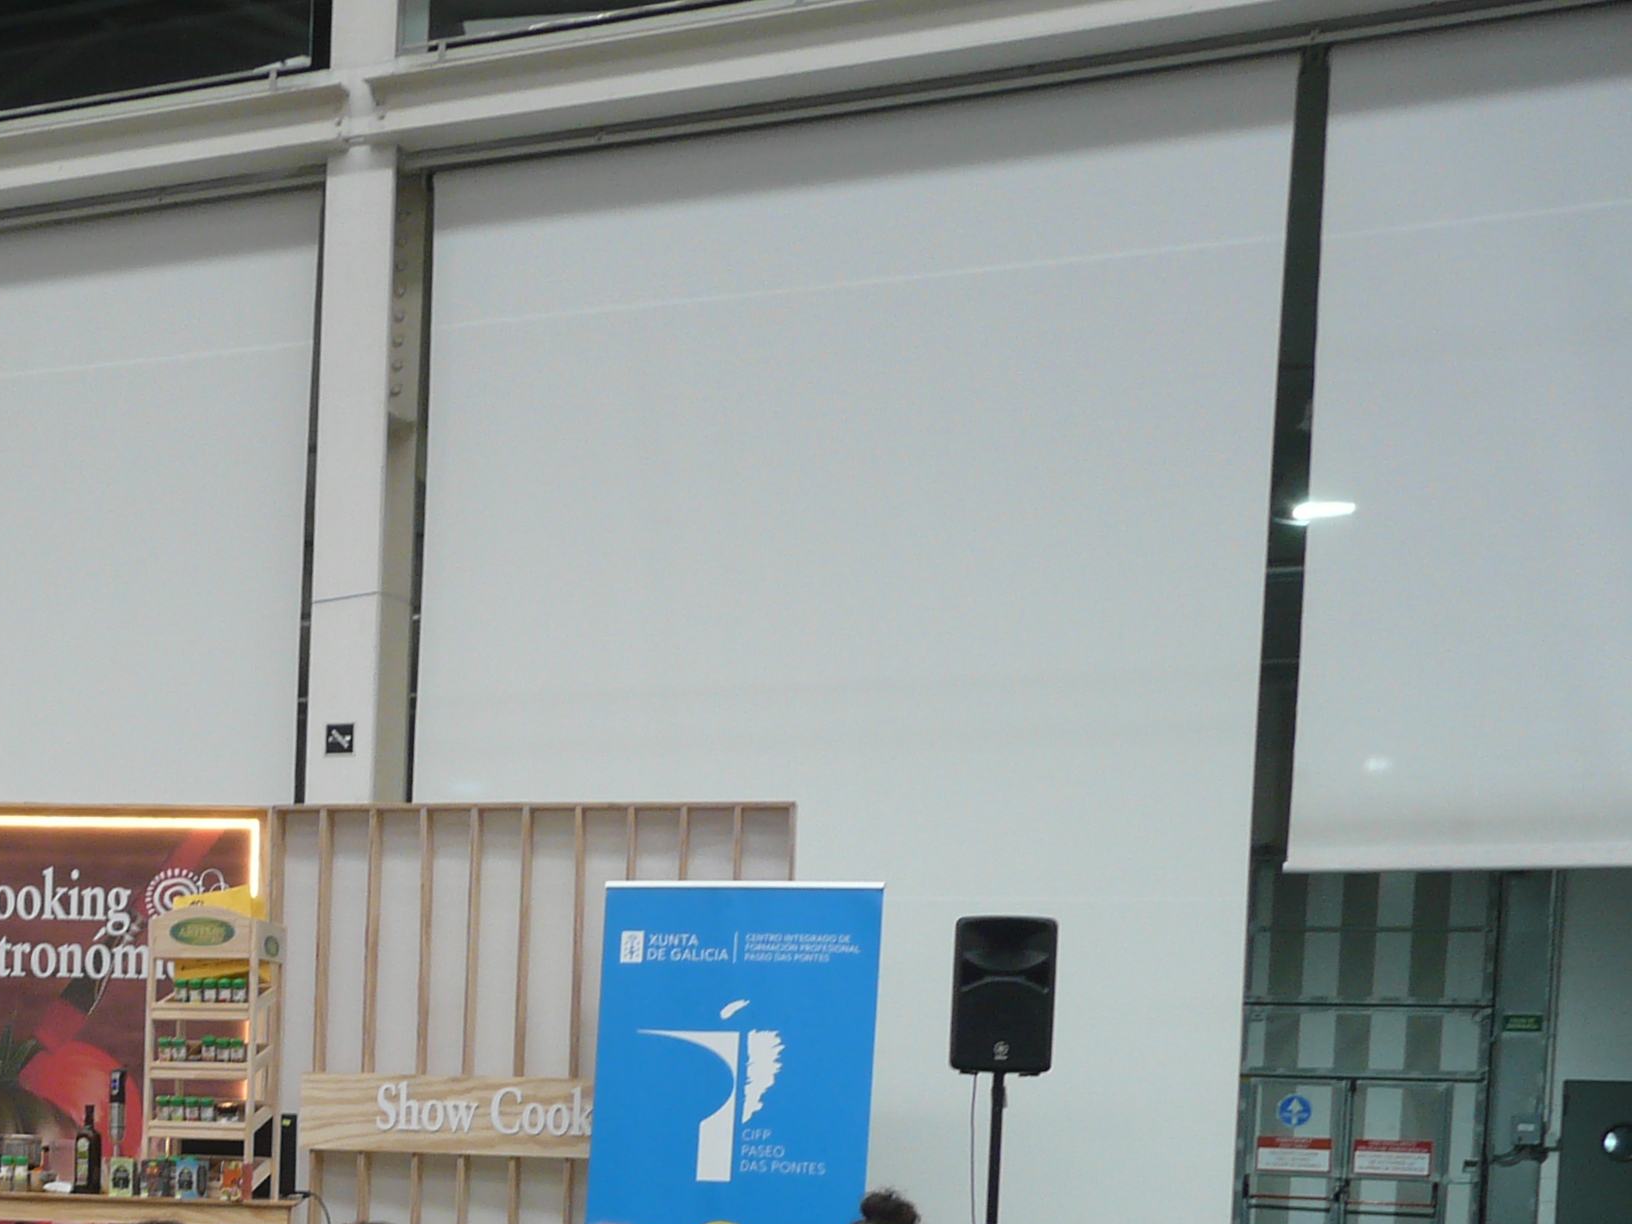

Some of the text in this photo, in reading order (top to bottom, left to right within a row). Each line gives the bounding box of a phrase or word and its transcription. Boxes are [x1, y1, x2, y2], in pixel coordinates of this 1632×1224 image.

[648, 933, 699, 947] XUNTA
[745, 932, 783, 942] CENTRO
[647, 947, 729, 962] DE GALICIA
[375, 1080, 593, 1137] Show Cook
[741, 1128, 772, 1141] CIFP
[740, 1144, 785, 1158] PASEO
[739, 1159, 826, 1175] DAS PONTES
